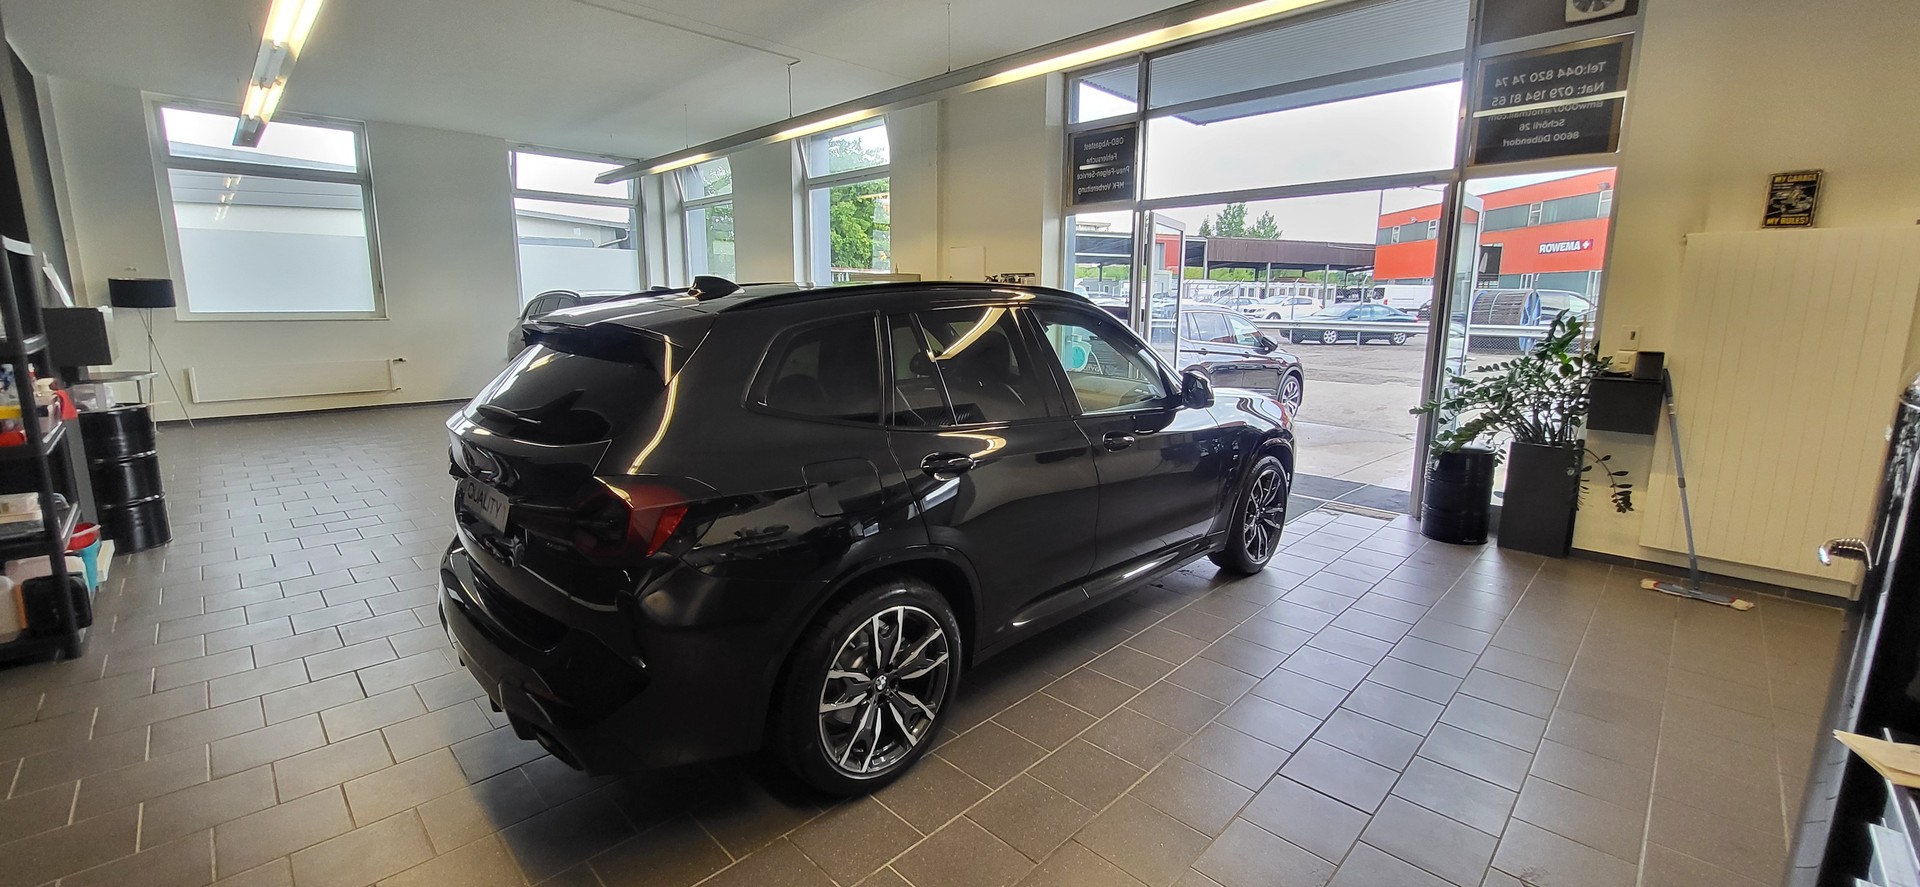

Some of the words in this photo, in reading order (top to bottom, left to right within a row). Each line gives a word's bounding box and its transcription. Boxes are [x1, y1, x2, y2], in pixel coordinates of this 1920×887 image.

[1766, 217, 1780, 225] MY
[1539, 240, 1581, 254] ROWEMA
[467, 482, 503, 519] QUALITY
